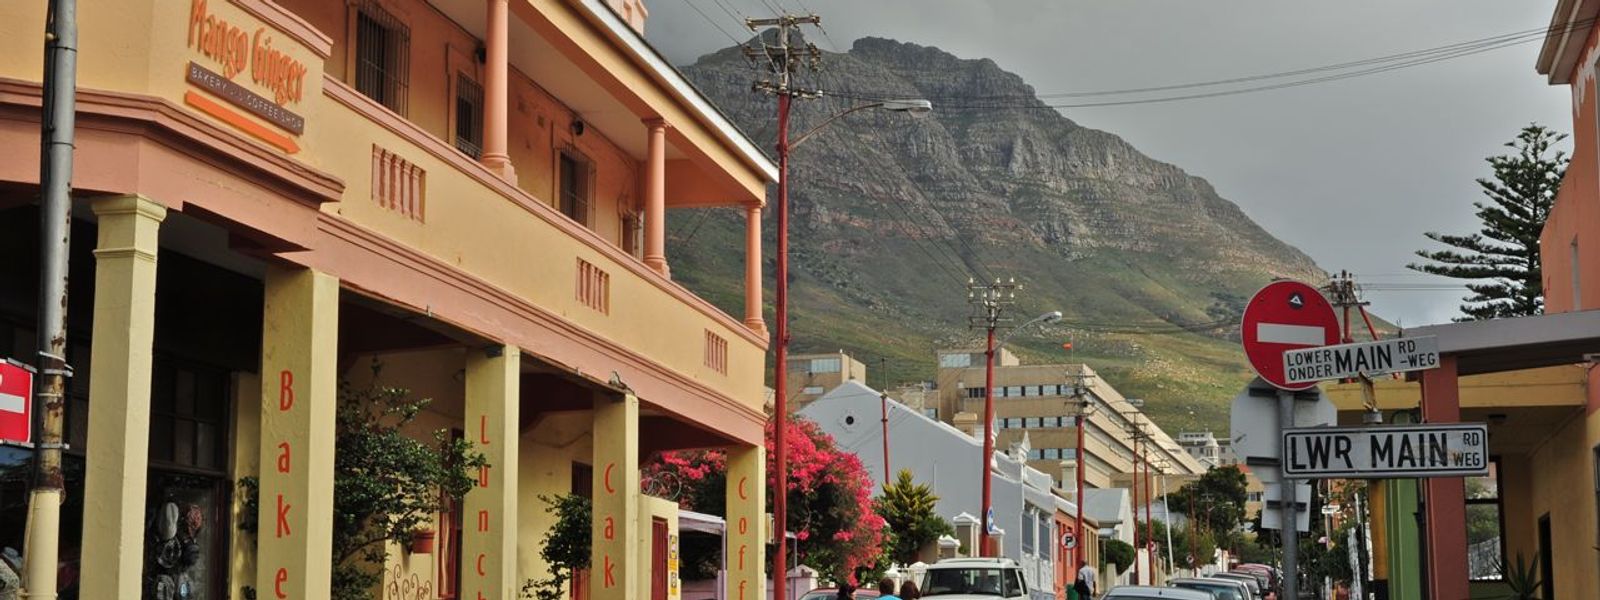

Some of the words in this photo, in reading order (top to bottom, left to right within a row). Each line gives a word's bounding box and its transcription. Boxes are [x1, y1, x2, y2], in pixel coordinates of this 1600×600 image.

[188, 0, 249, 80] Mango
[252, 27, 307, 106] Ginger
[191, 66, 228, 92] BAKERY
[246, 94, 278, 119] COFFEE
[1286, 350, 1332, 366] LOWER
[1334, 344, 1393, 373] MAIN
[1398, 340, 1416, 353] RD
[1288, 364, 1333, 381] ONDER
[1290, 435, 1353, 470] LWR
[1370, 432, 1448, 469] MAIN
[1463, 432, 1480, 447] RD
[1453, 452, 1480, 467] WEG
